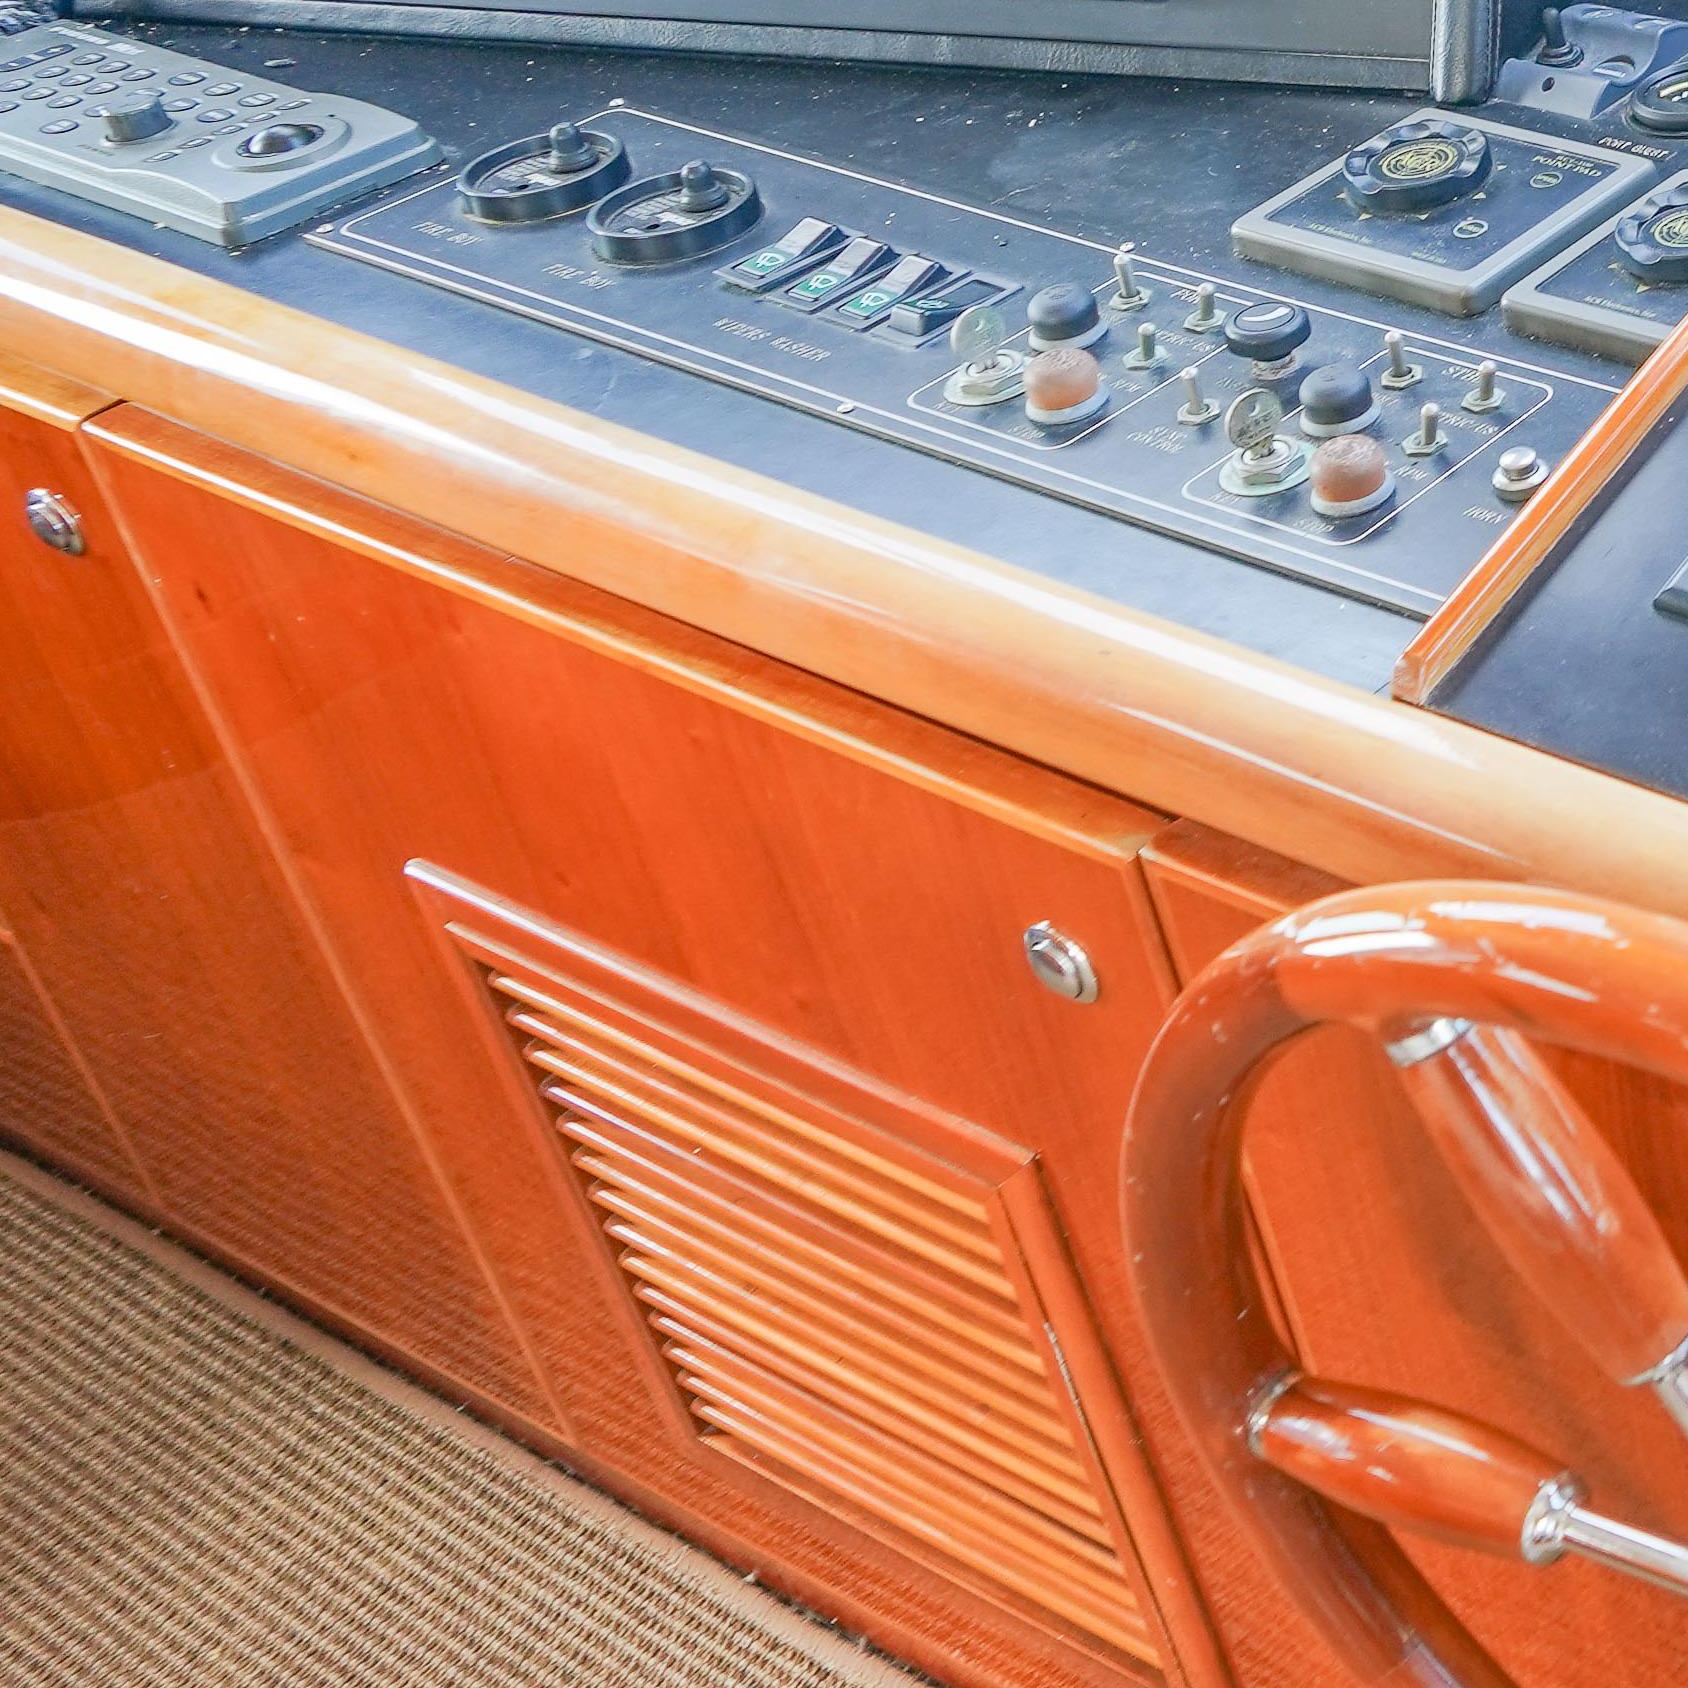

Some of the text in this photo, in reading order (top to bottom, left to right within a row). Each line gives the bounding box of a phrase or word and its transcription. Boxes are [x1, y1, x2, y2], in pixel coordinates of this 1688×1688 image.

[1598, 136, 1632, 150] PORT
[412, 220, 456, 238] FIRE
[542, 262, 582, 281] FIRE
[1462, 504, 1508, 525] HORN
